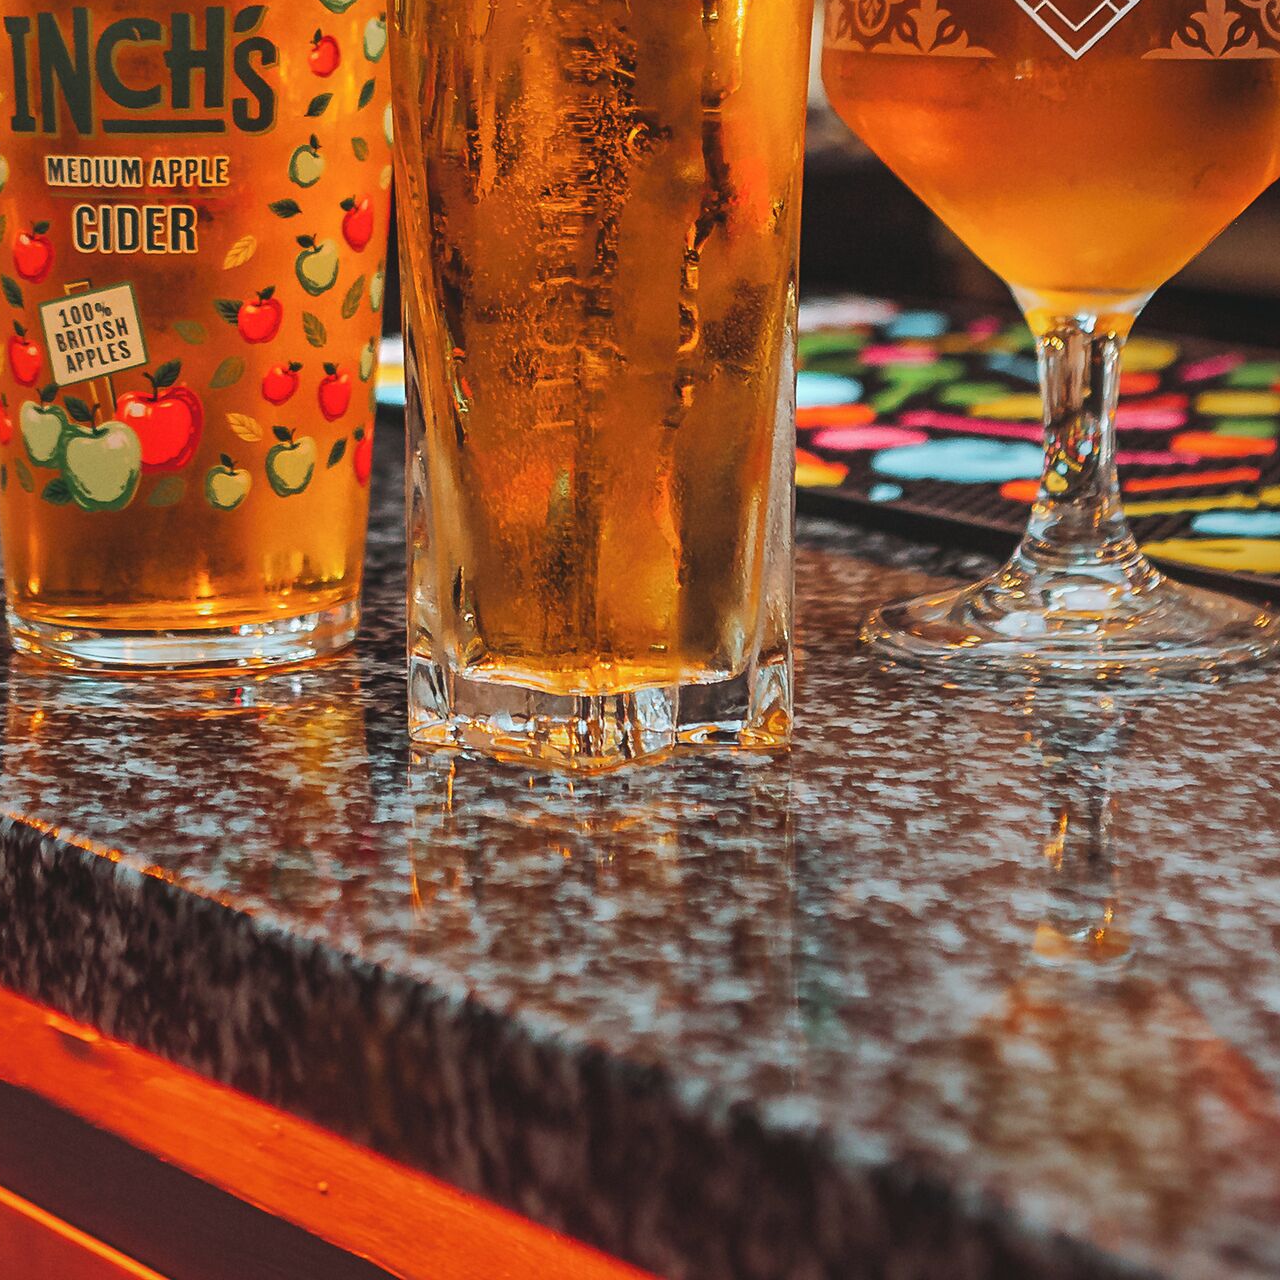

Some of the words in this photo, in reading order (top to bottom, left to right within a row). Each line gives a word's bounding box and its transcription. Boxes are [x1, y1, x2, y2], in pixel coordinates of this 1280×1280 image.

[45, 156, 144, 187] MEDIUM
[150, 156, 230, 187] APPLE
[73, 204, 199, 253] CIDER
[58, 302, 112, 328] 100%
[55, 317, 129, 353] BRITISH
[66, 340, 132, 374] APPLES
